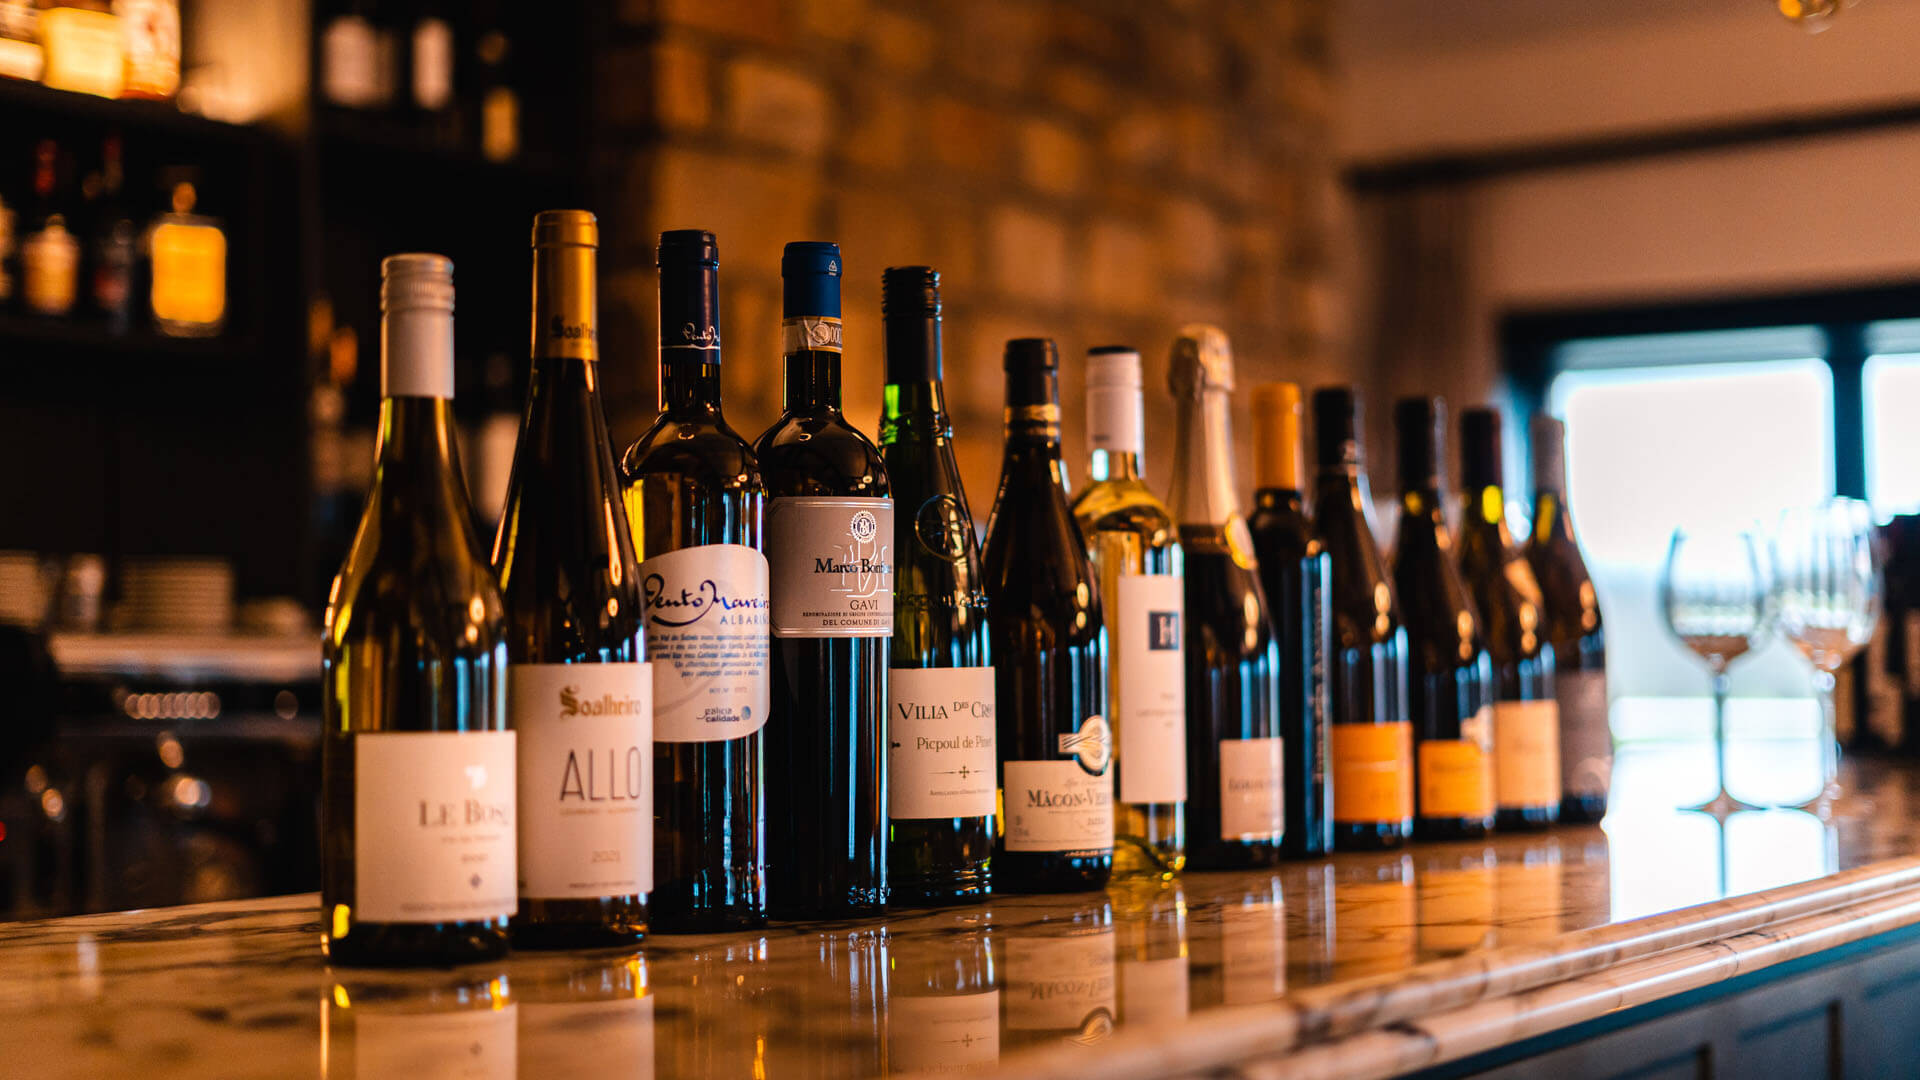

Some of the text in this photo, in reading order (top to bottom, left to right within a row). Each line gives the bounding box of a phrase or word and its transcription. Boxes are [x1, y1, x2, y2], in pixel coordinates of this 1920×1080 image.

[814, 558, 858, 574] Marco
[849, 600, 878, 611] GAVI
[822, 618, 838, 627] DEL
[840, 618, 872, 627] COMUNE
[559, 685, 641, 720] Soalheiro
[706, 714, 741, 723] calidade
[916, 735, 960, 753] Picpoul
[962, 735, 974, 748] de
[559, 746, 642, 801] ALLO
[418, 800, 457, 827] LE
